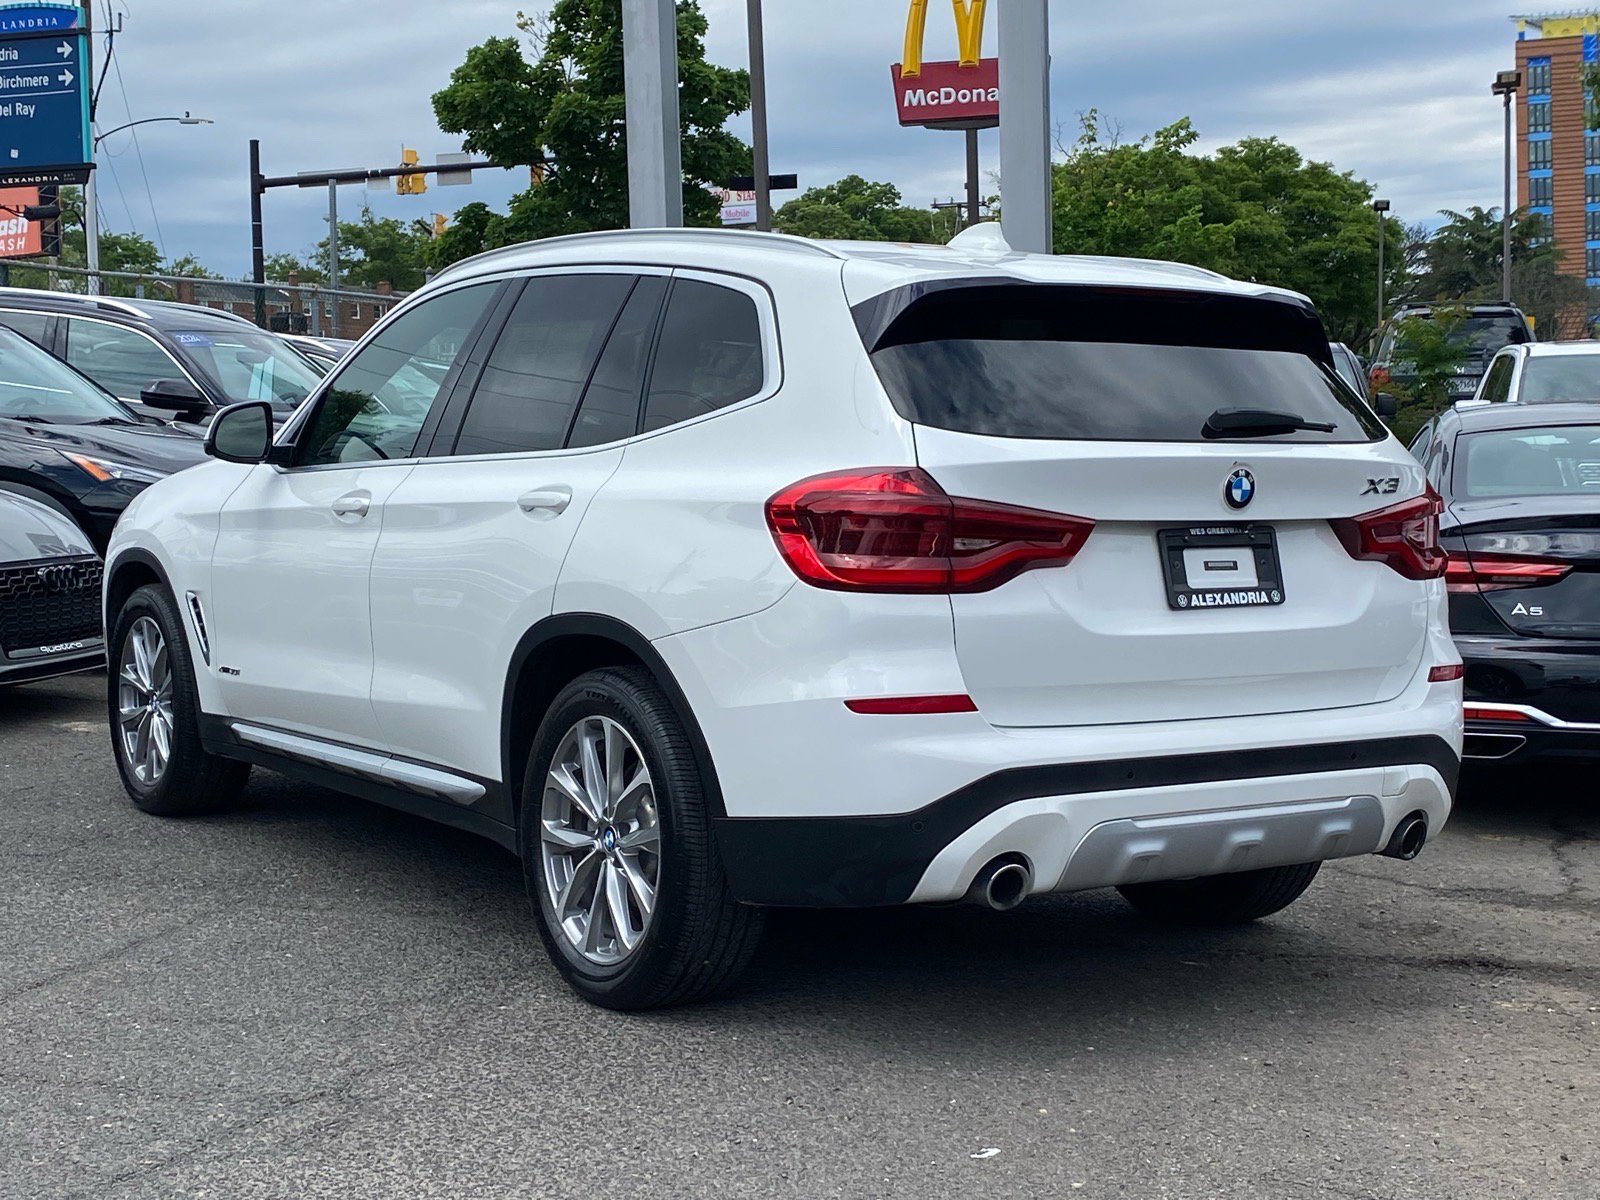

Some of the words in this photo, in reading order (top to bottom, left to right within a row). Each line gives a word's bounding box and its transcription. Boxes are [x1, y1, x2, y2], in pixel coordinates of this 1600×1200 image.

[903, 87, 999, 107] McDona
[16, 102, 35, 118] Ray
[0, 175, 60, 184] LEXANDRIA
[1360, 477, 1400, 496] X3
[1191, 591, 1270, 607] ALEXANDRIA
[1511, 602, 1543, 616] A5
